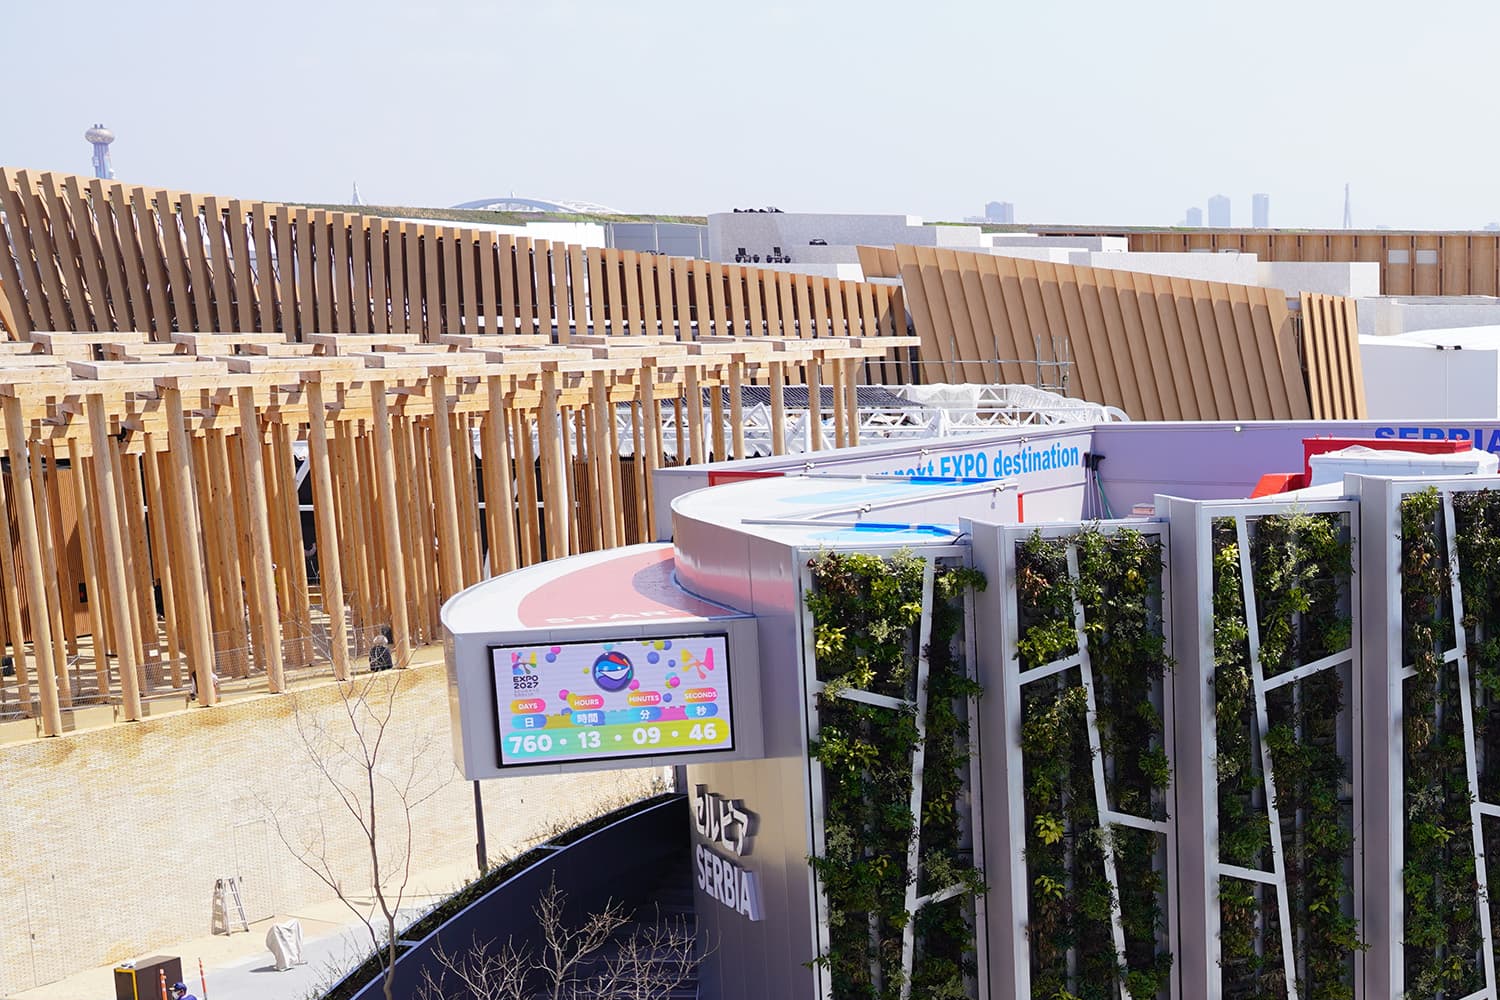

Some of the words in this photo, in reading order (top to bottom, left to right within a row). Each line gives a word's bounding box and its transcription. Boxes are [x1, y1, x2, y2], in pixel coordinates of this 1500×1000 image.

[940, 452, 987, 478] EXPO
[994, 442, 1079, 477] destination
[513, 675, 539, 683] EXPO
[513, 682, 539, 690] 2027
[629, 695, 660, 703] MINUTES
[684, 691, 717, 700] SECONDS
[574, 698, 599, 706] HOURS
[525, 717, 535, 727] 日
[508, 734, 552, 754] 760
[577, 730, 601, 748] 13
[632, 726, 661, 745] 09
[688, 723, 717, 740] 46
[696, 843, 760, 921] SERBIA
